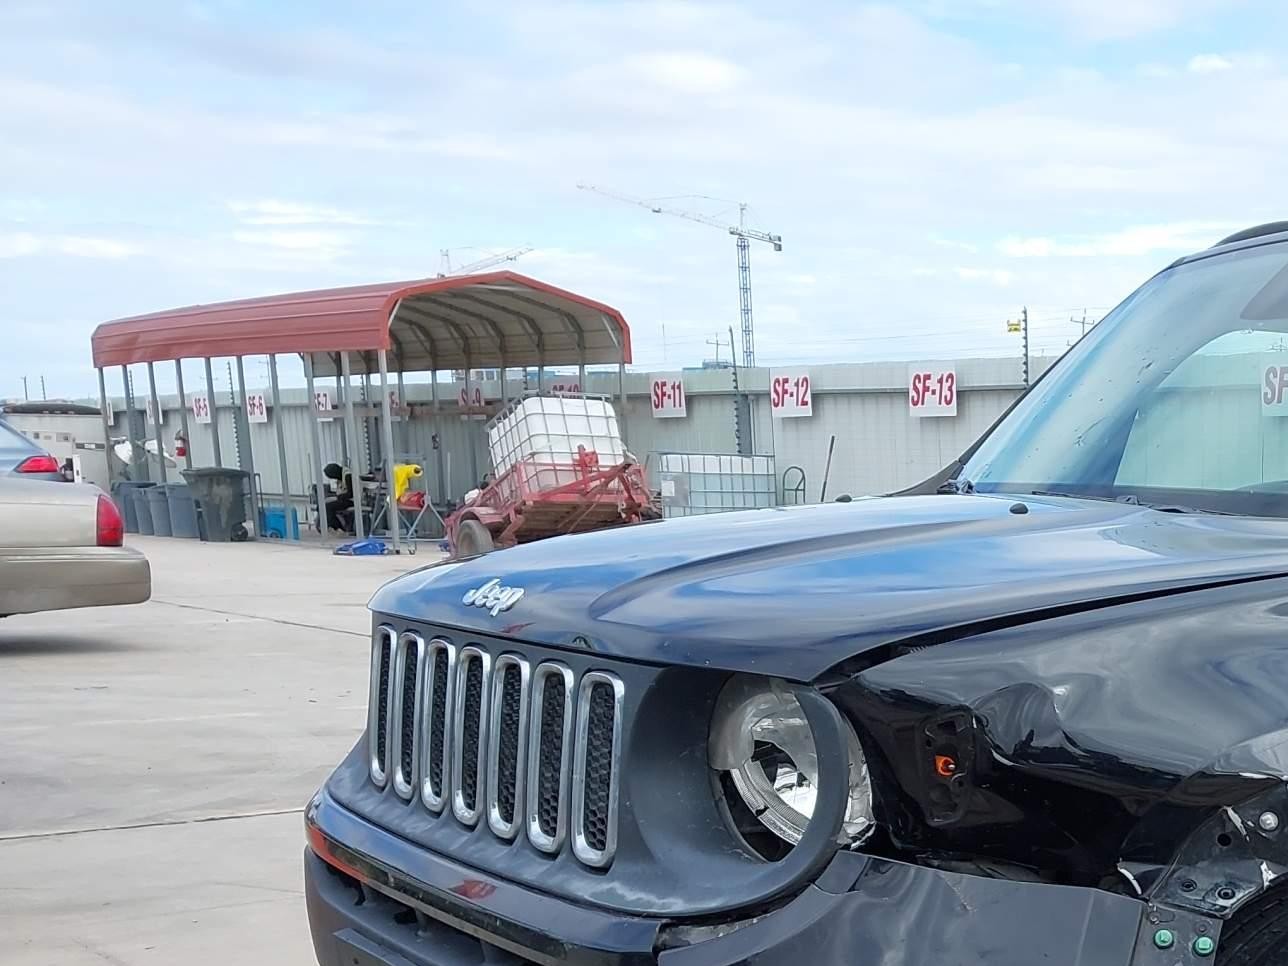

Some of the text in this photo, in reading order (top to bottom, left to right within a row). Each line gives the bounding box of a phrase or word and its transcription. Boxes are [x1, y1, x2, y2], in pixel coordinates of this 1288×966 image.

[652, 380, 683, 409] SF-11
[772, 376, 810, 408] SF-12
[911, 372, 956, 407] SF-13
[462, 578, 525, 617] Jeep
